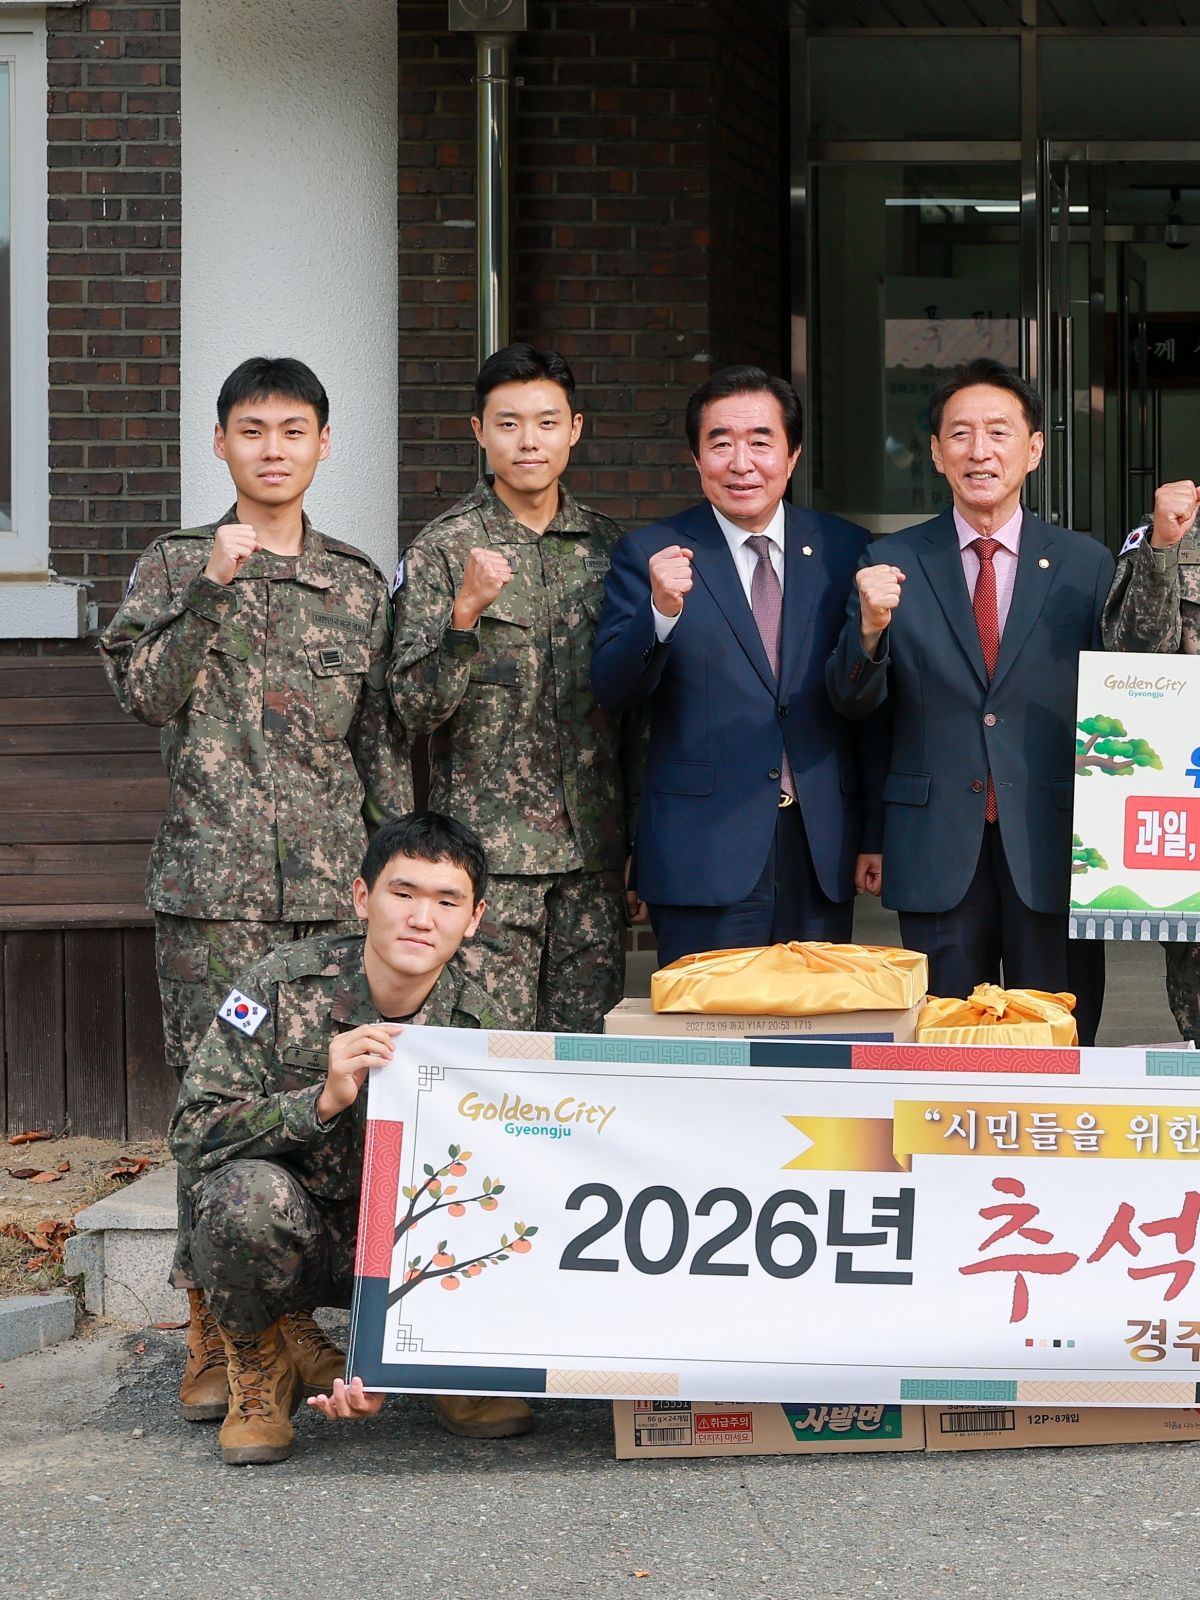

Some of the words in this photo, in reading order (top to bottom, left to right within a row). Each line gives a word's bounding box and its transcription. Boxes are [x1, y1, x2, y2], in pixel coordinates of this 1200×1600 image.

[314, 614, 339, 627] 대한민국
[1104, 674, 1156, 692] Golden
[1154, 676, 1188, 697] City
[1128, 689, 1164, 699] Gyeongju
[1134, 809, 1197, 861] 과일,
[685, 1021, 727, 1032] 2027.03.09
[729, 1021, 745, 1031] 까지
[747, 1020, 766, 1030] Y1A7
[768, 1020, 790, 1031] 20:53
[793, 1020, 812, 1030] 1713
[457, 1091, 550, 1124] Golden
[554, 1096, 617, 1135] City
[503, 1122, 573, 1139] Gyeongju
[924, 1106, 1106, 1152] “시민들을
[558, 1182, 916, 1287] 2026년
[710, 1416, 750, 1428] 취급주의
[698, 1433, 723, 1444] 던지지
[724, 1432, 750, 1442] 마세요
